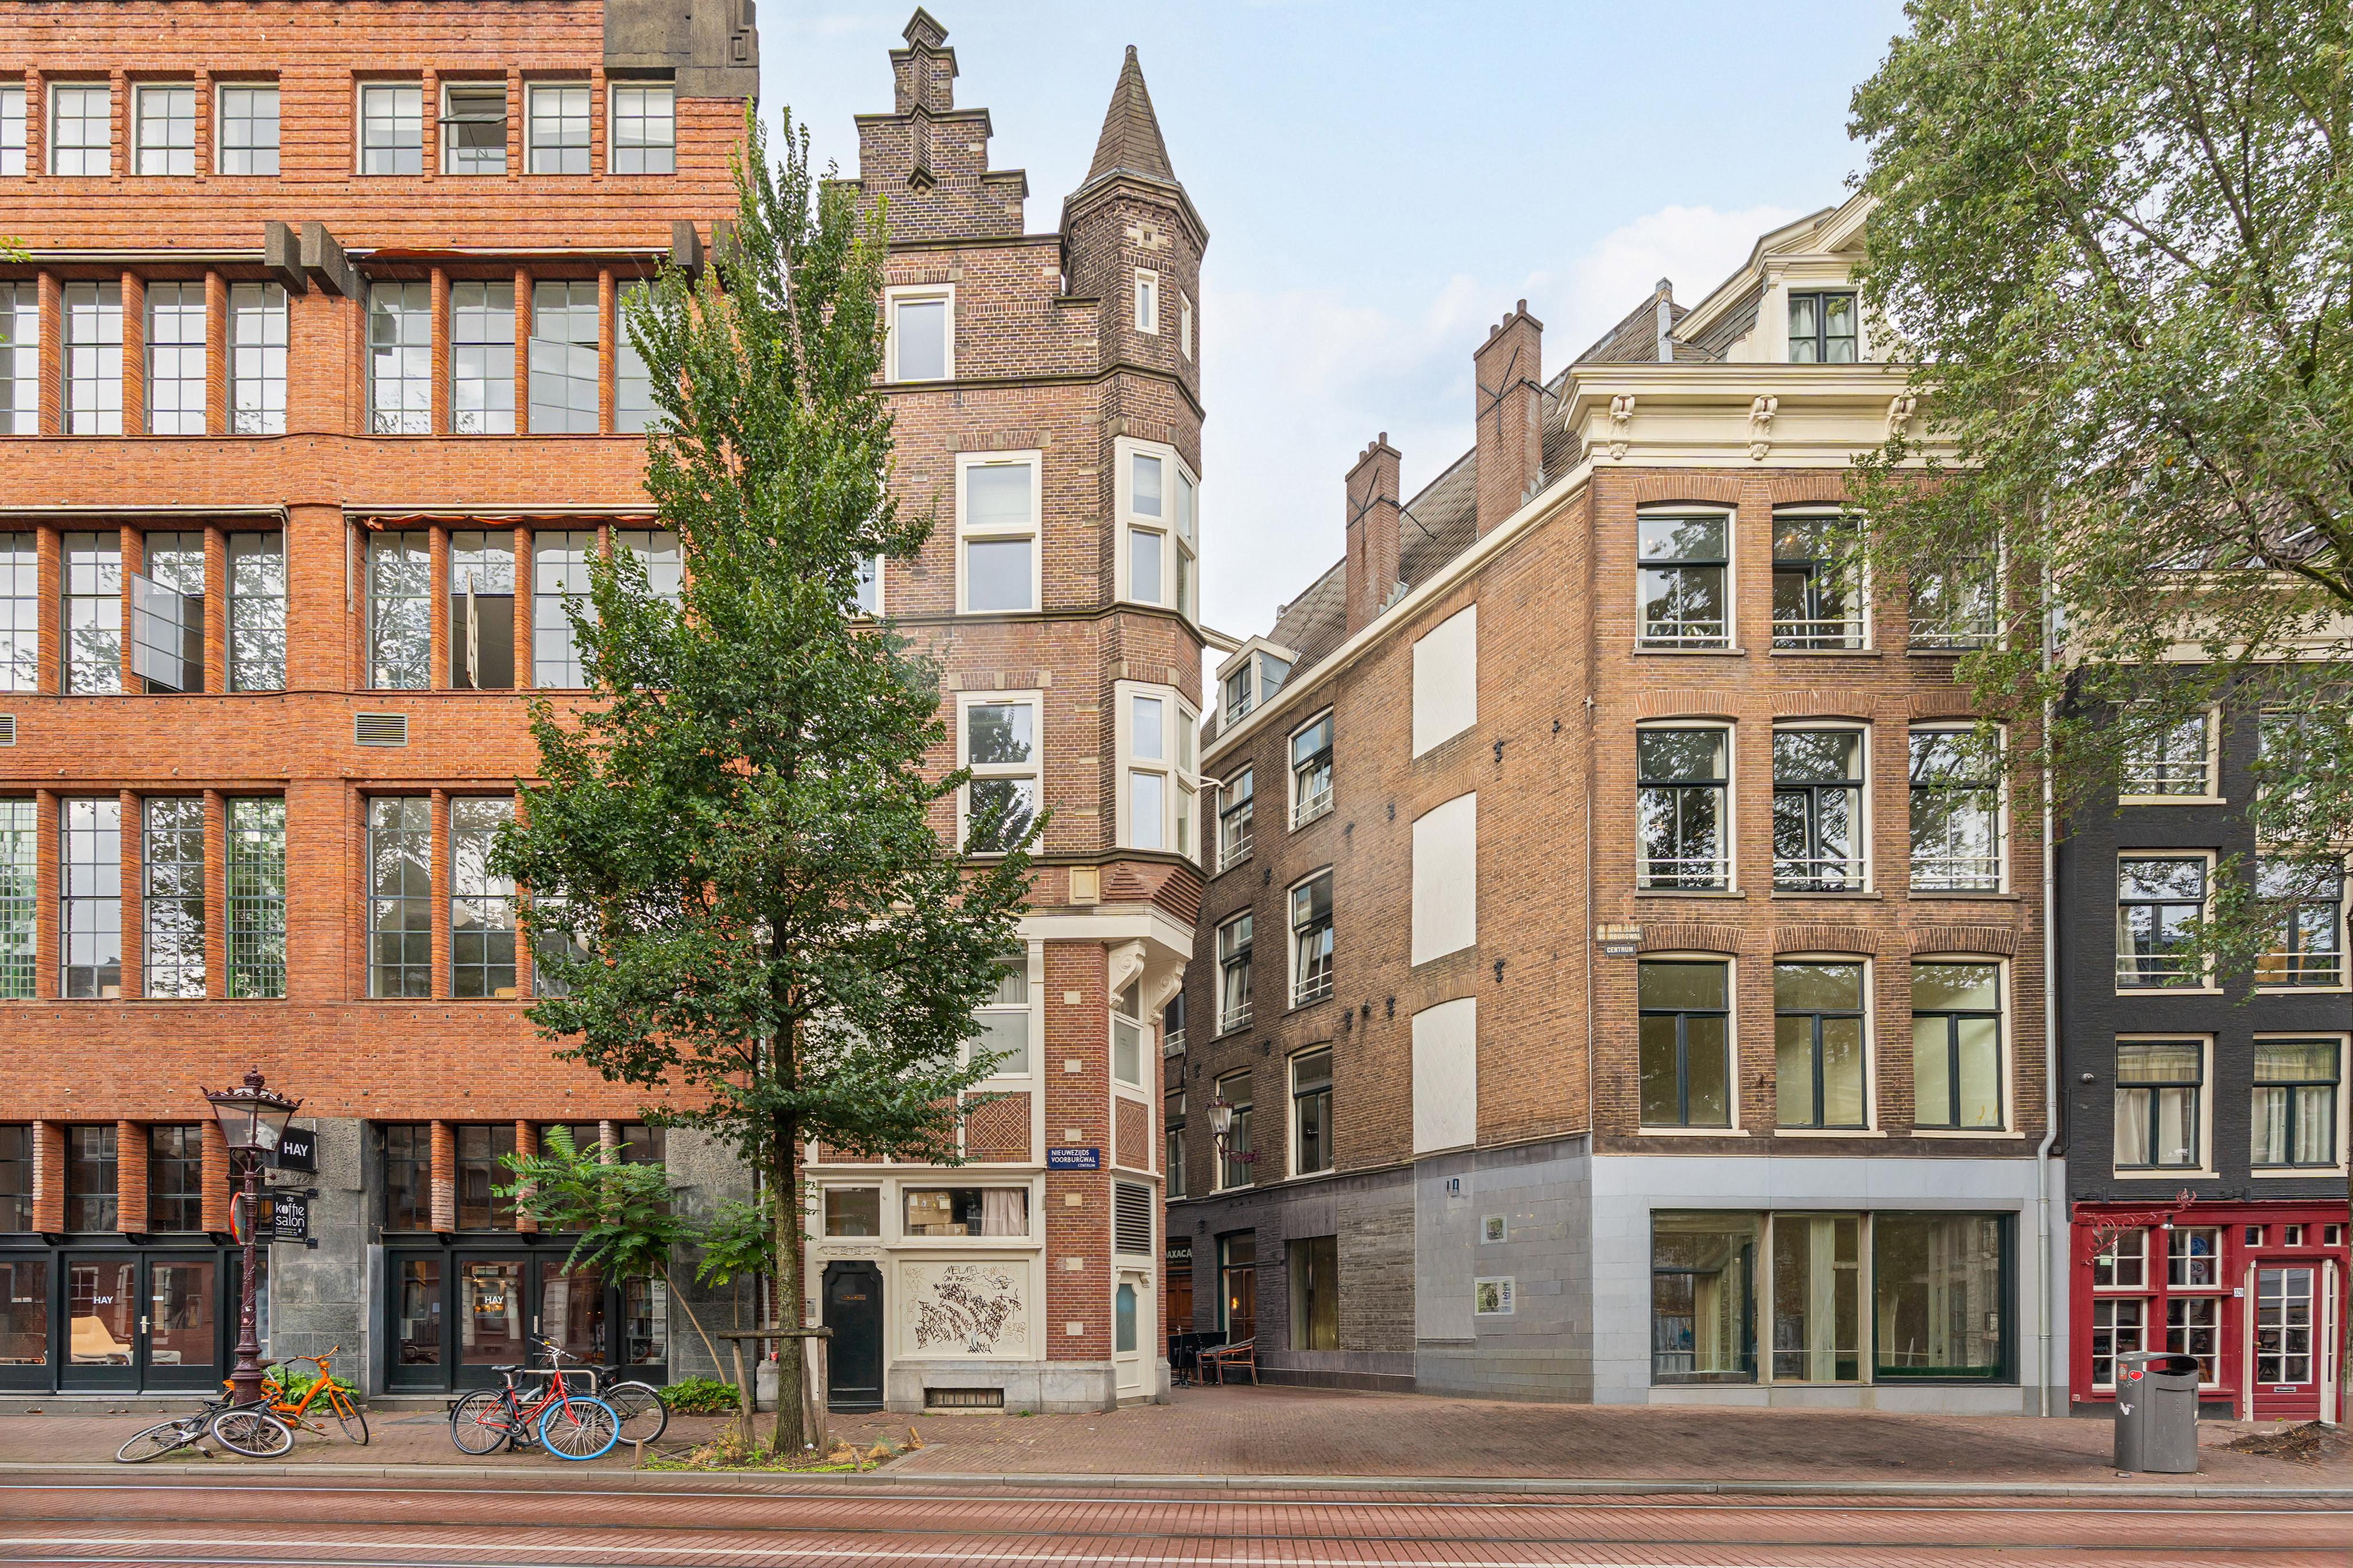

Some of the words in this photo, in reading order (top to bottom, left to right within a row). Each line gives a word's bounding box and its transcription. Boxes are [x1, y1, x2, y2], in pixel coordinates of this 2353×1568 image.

[284, 1141, 308, 1157] HAY
[276, 1202, 305, 1217] koffie
[276, 1215, 305, 1227] salon
[1166, 1248, 1193, 1258] AXACA
[2234, 1288, 2243, 1296] 320
[94, 1296, 114, 1304] HAY
[484, 1296, 504, 1304] HAY
